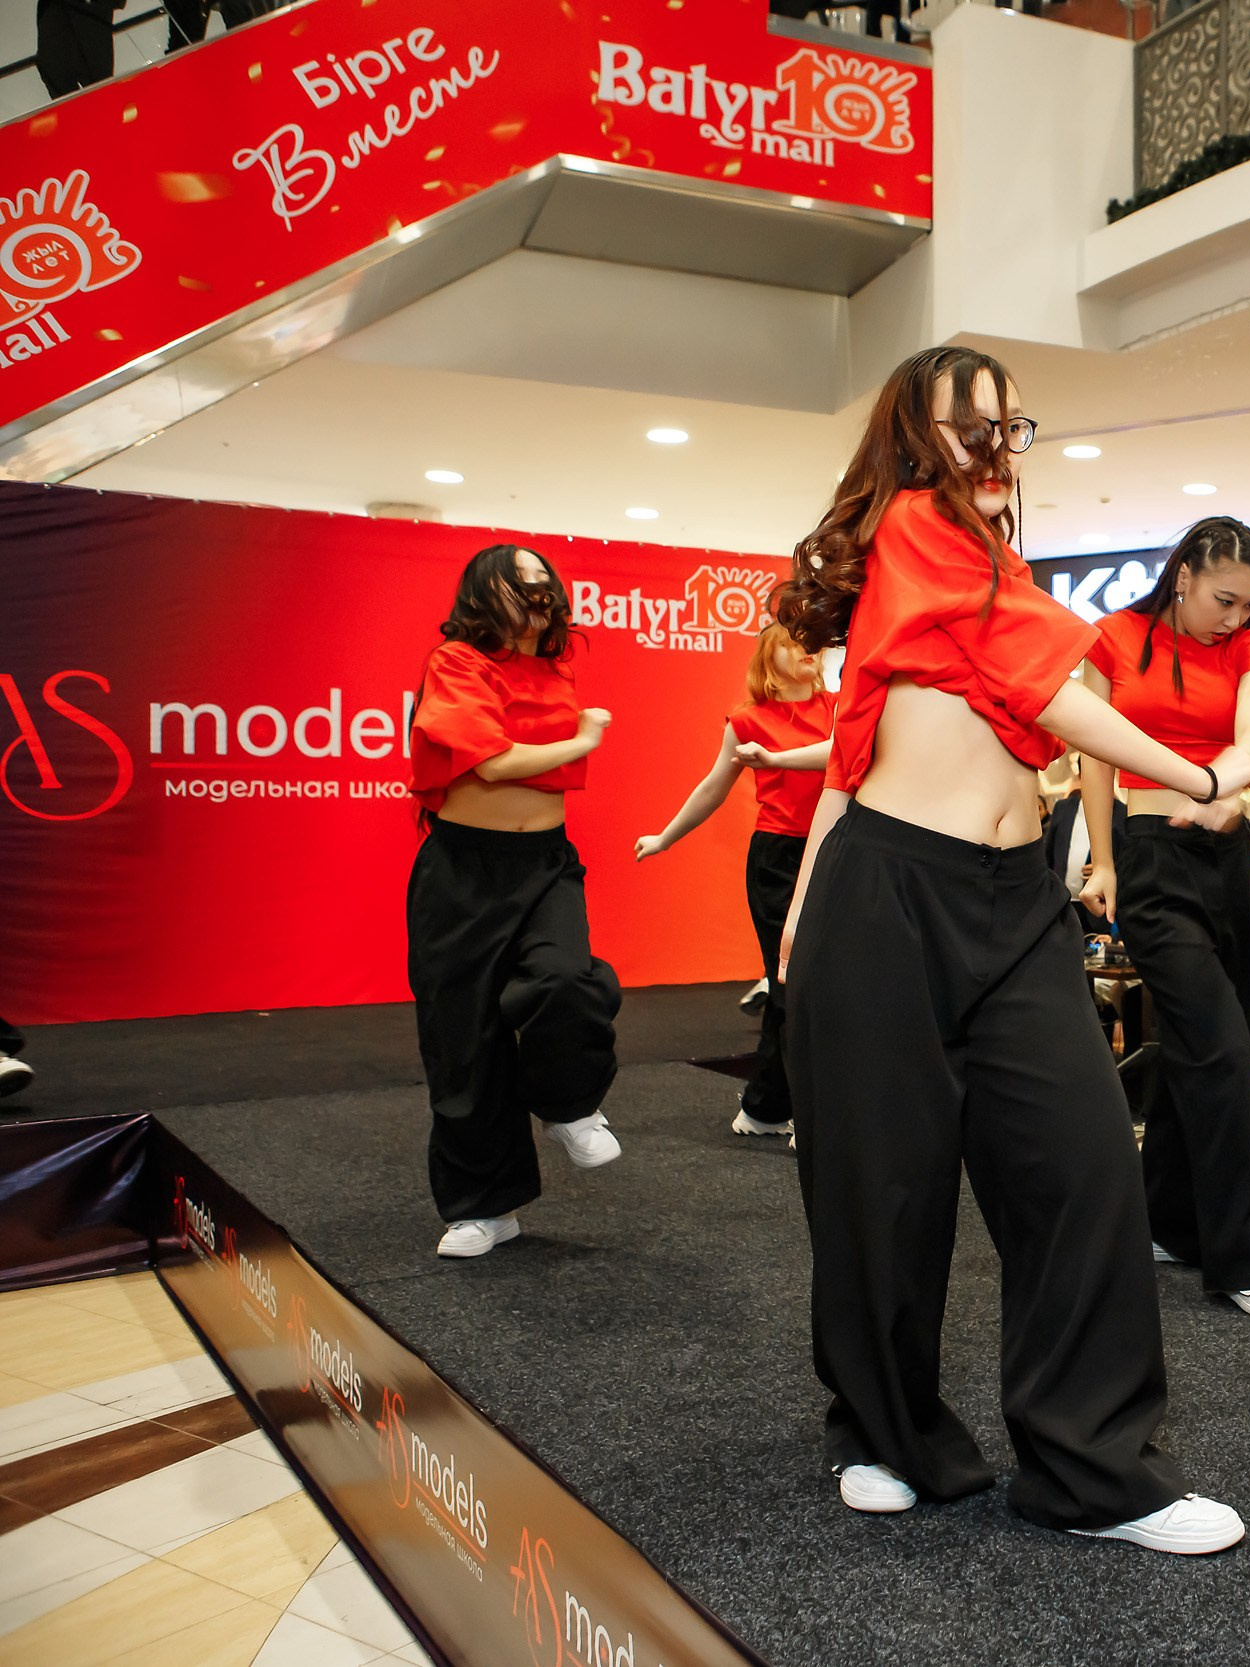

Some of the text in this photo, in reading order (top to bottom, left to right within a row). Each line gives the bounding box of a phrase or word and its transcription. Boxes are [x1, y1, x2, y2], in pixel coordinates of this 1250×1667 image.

[292, 27, 446, 109] Бірге
[598, 40, 779, 149] Batyr
[232, 46, 499, 232] Вместе
[752, 130, 835, 167] mall
[571, 580, 688, 648] Batyr
[669, 631, 723, 652] mall
[150, 688, 415, 759] model
[165, 777, 413, 802] модельная шко
[239, 1253, 277, 1318] models
[310, 1326, 362, 1412] models
[411, 1432, 488, 1549] models
[415, 1497, 483, 1584] модельная школа
